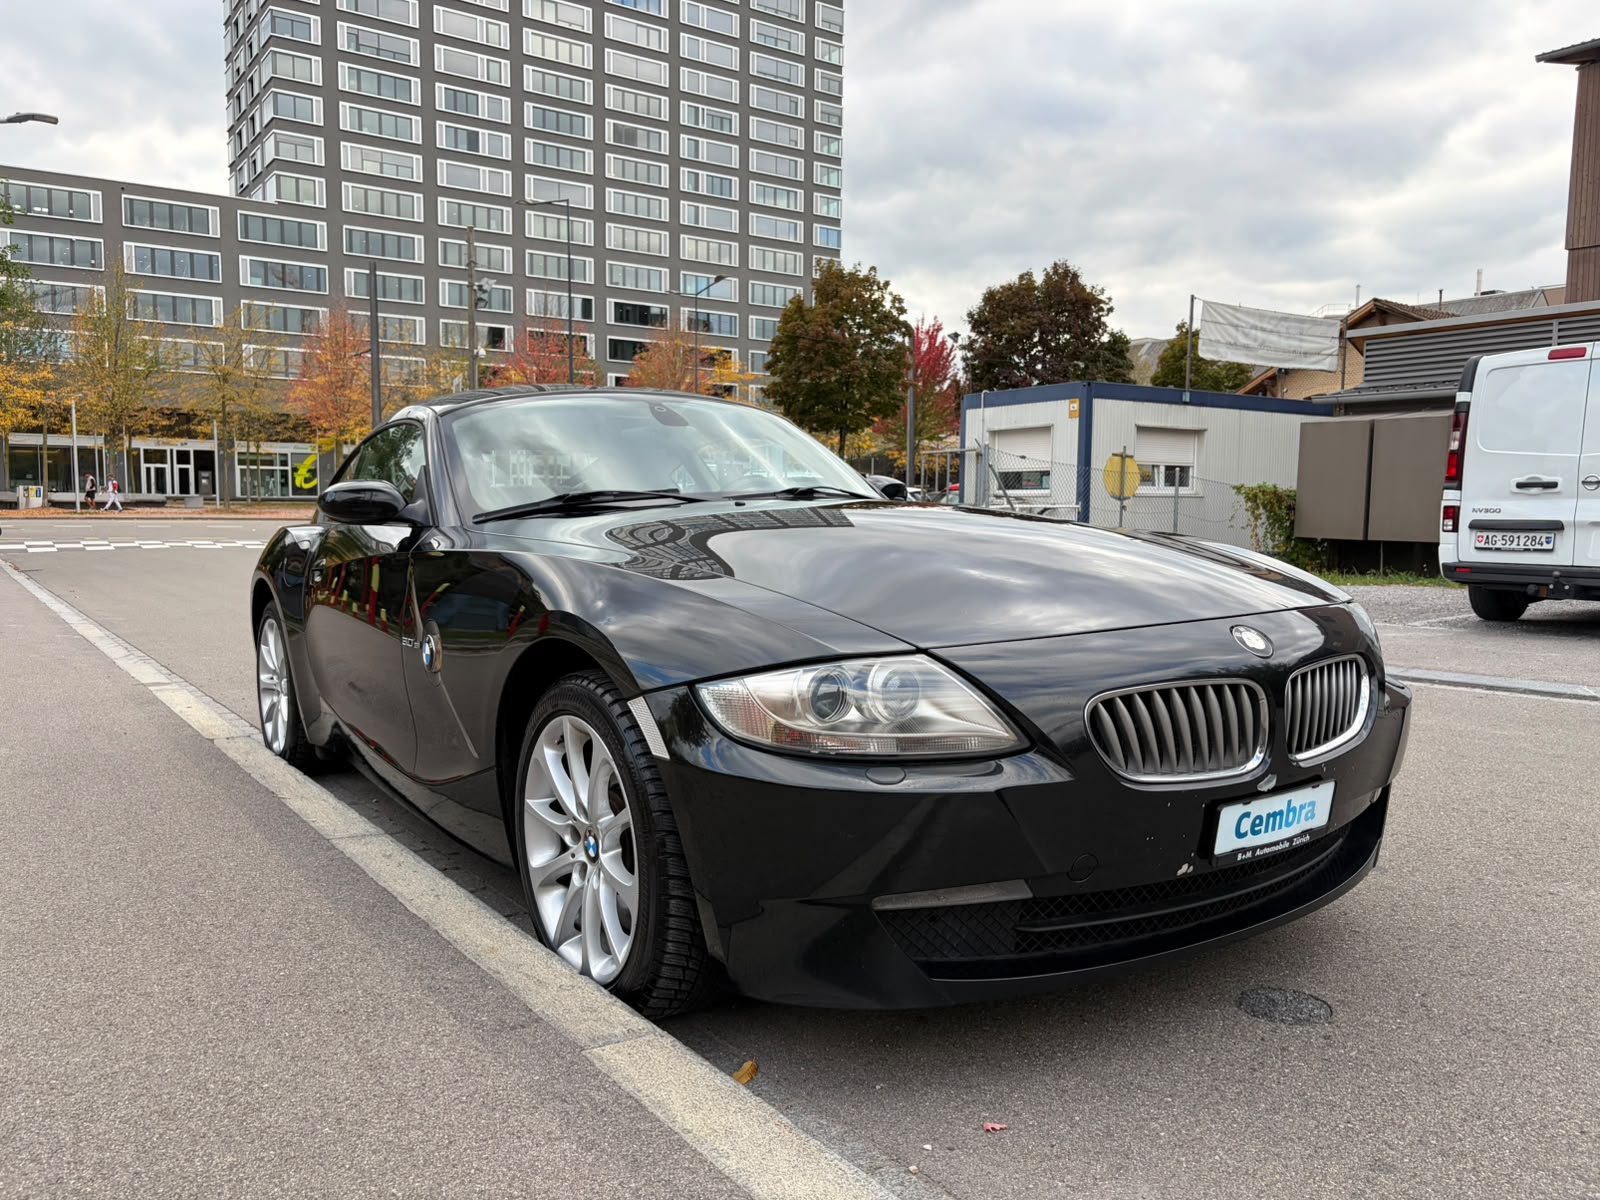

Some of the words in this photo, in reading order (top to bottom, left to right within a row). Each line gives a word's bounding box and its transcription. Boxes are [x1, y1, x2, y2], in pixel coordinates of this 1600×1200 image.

[1234, 799, 1316, 839] Cembra
[1255, 840, 1289, 856] Automobile
[1292, 834, 1310, 846] Zürich
